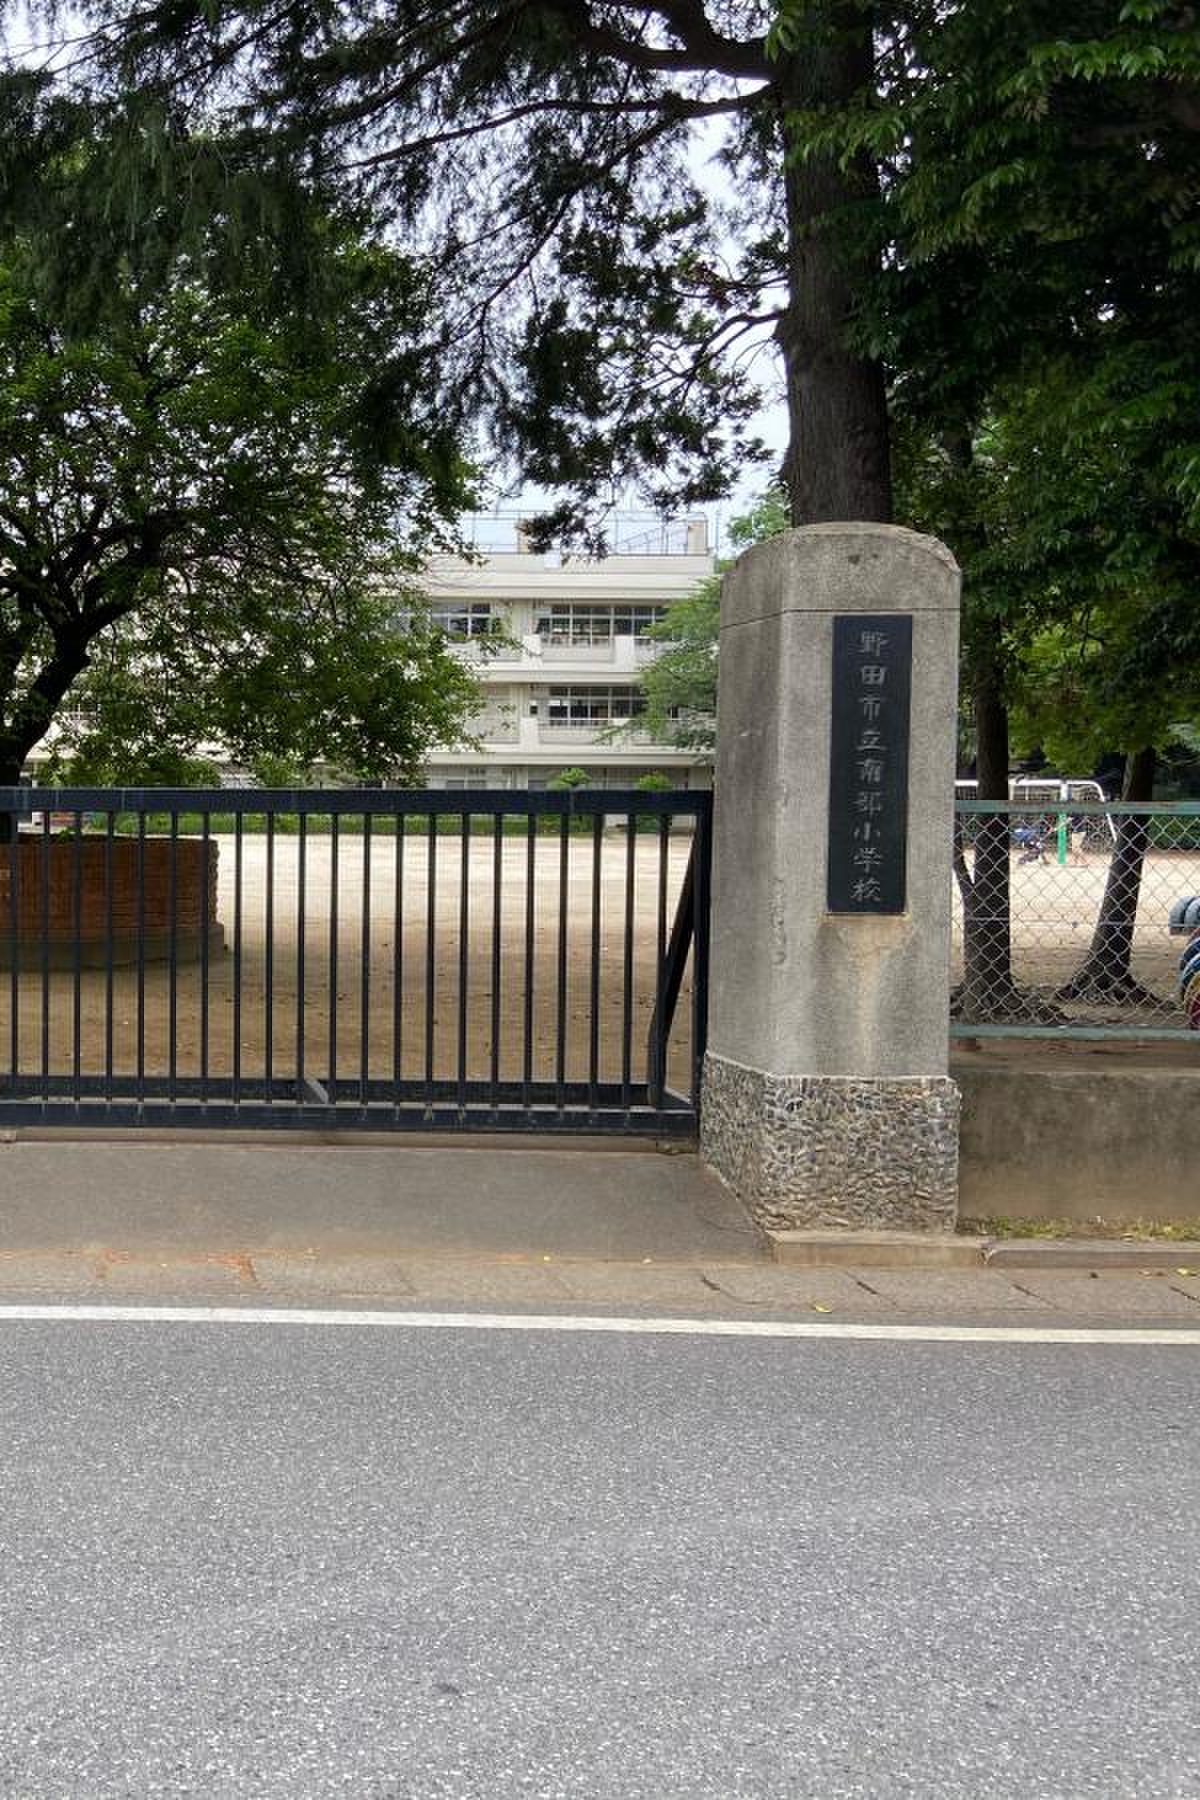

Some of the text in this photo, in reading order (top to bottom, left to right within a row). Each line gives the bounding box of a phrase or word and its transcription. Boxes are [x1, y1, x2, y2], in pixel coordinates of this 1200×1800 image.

[850, 630, 889, 901] 野田市立南部小学校
